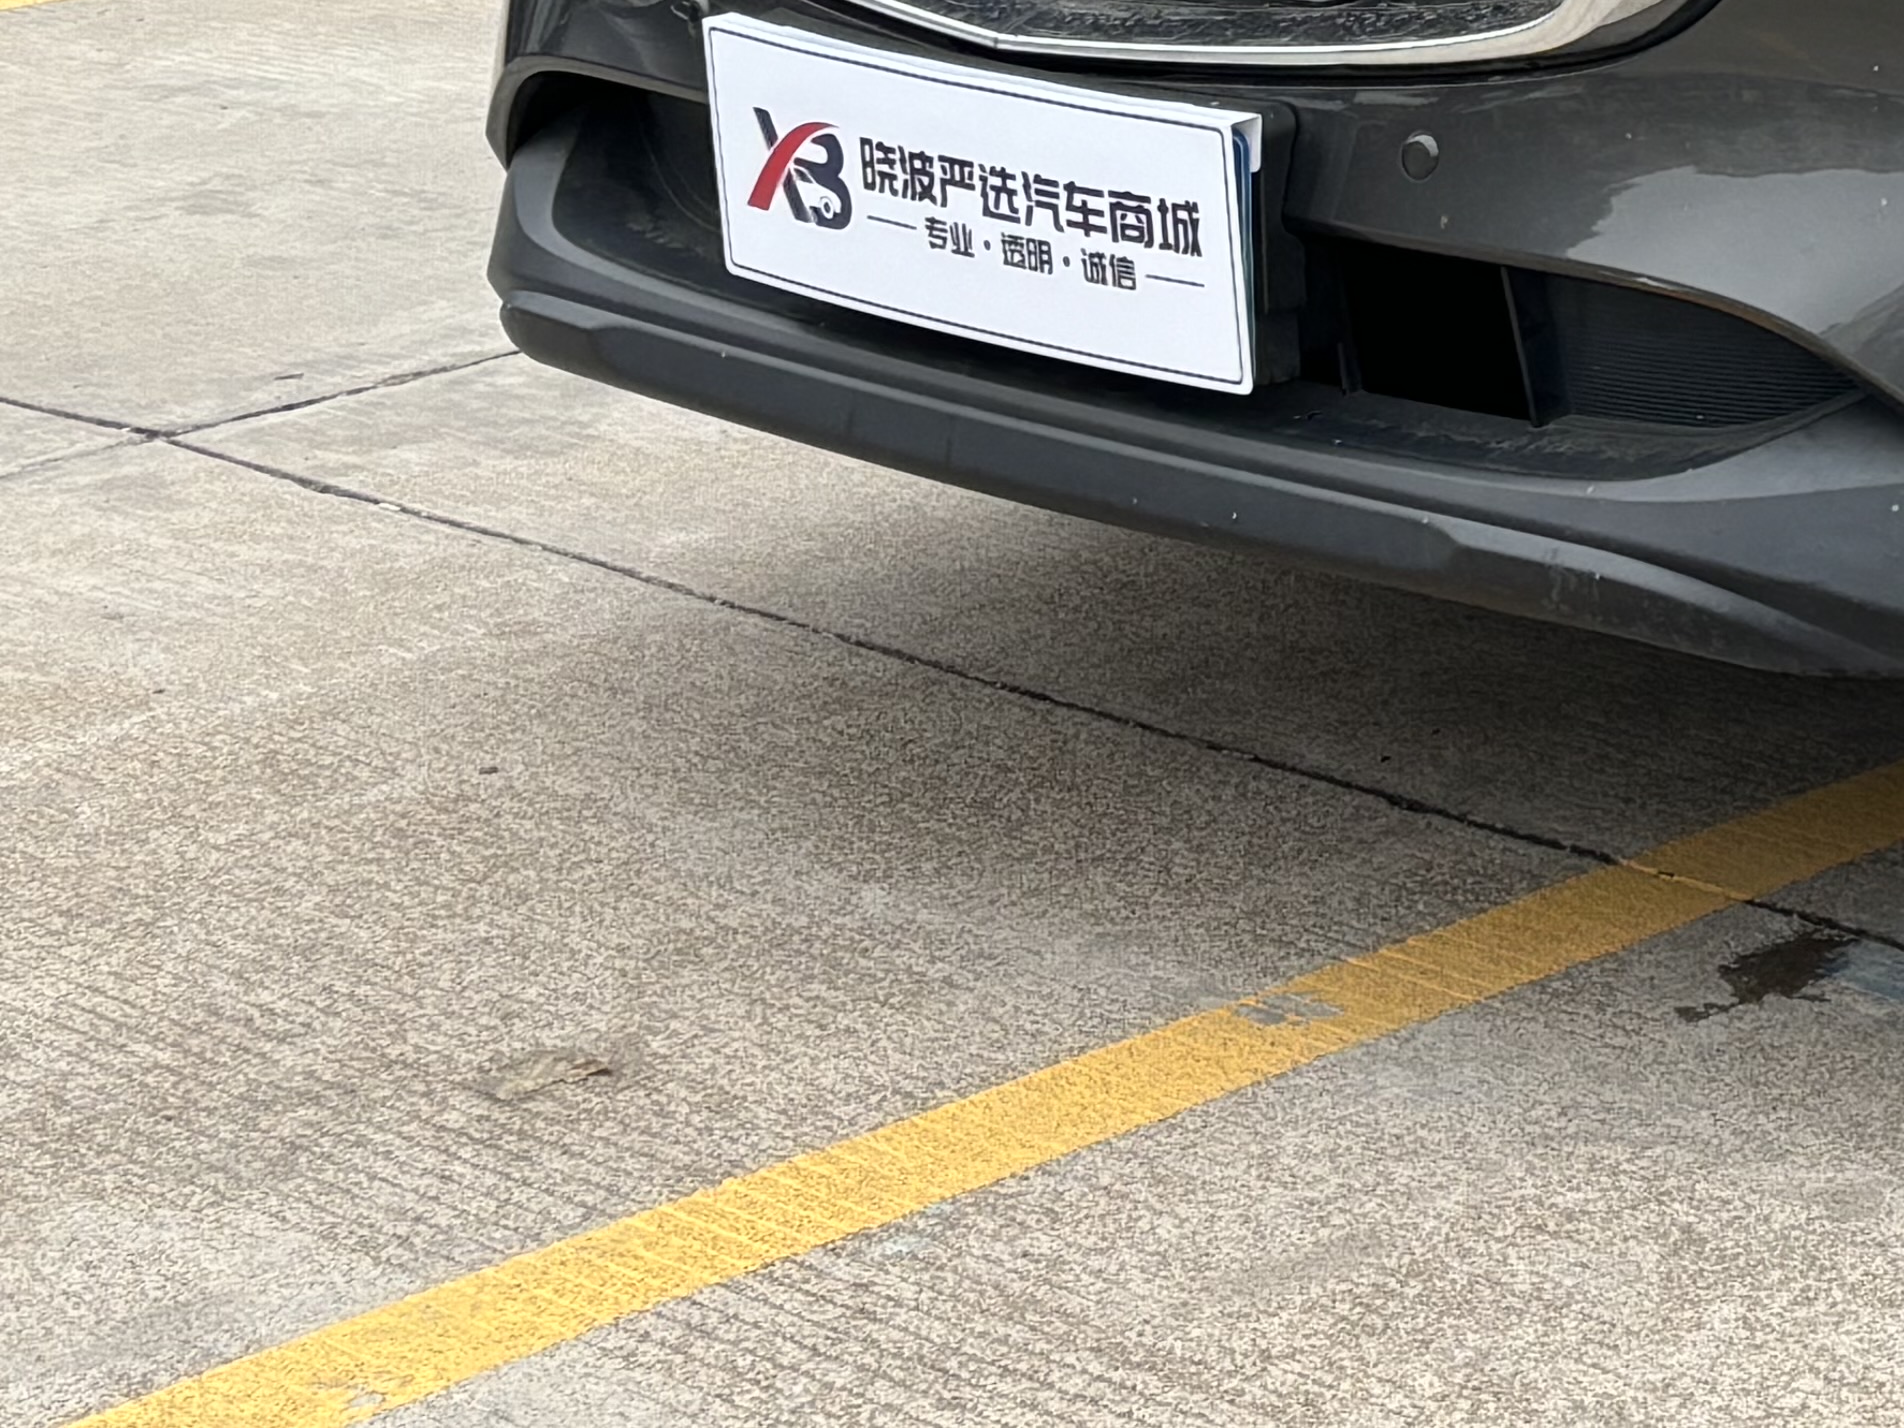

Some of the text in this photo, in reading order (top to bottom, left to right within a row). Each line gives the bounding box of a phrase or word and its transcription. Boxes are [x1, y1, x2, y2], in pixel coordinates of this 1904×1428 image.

[858, 135, 1203, 258] 晓波严选汽车商城
